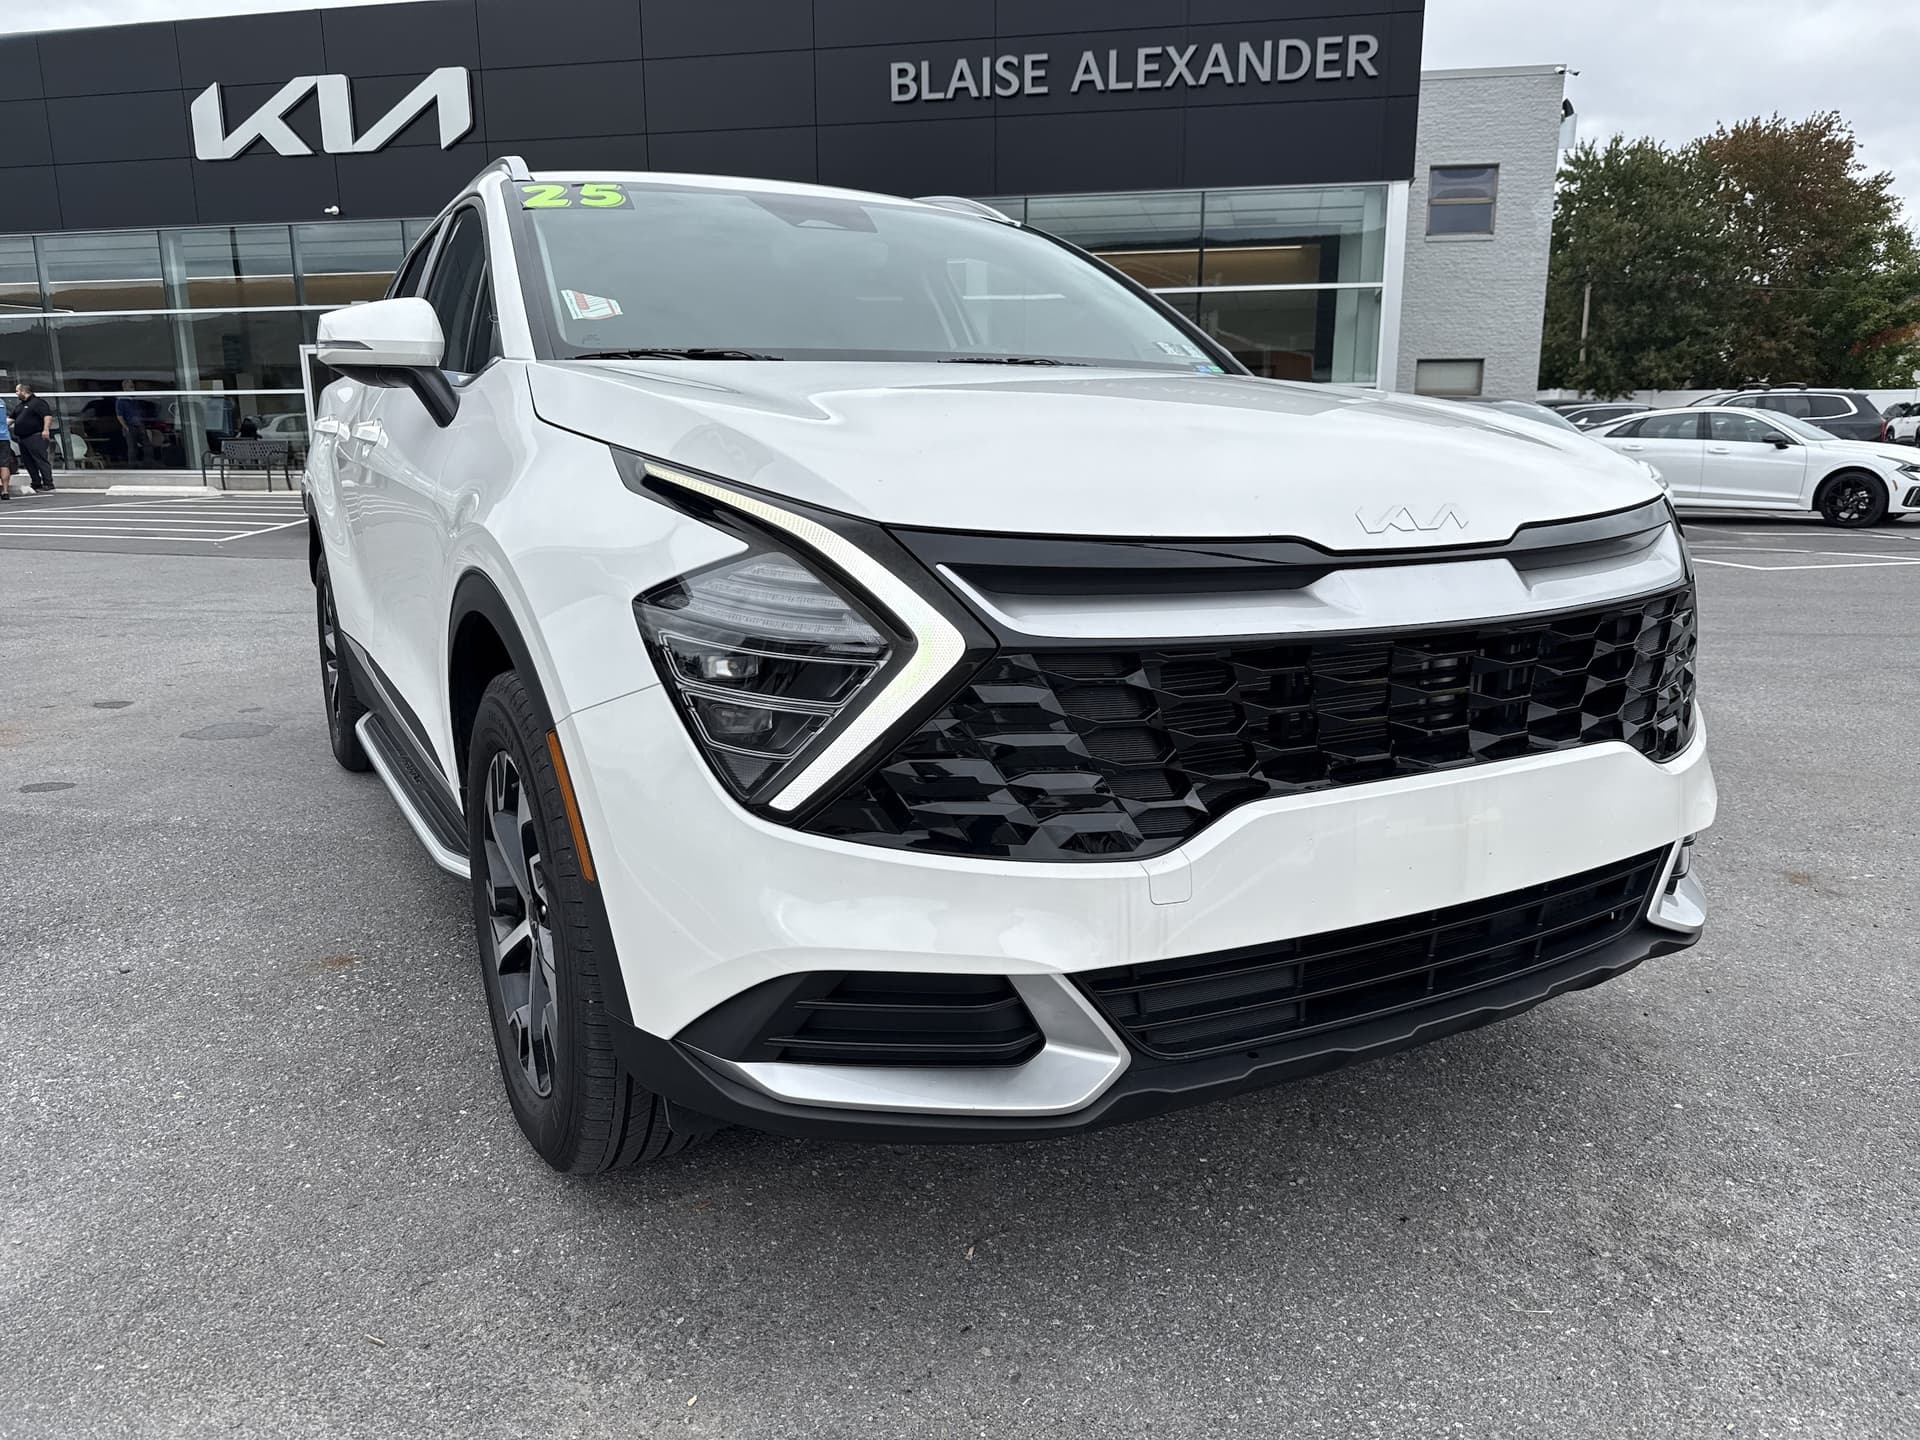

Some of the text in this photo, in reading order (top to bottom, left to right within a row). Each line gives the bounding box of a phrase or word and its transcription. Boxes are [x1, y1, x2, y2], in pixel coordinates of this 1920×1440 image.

[890, 34, 1379, 102] BLAISE ALEXANDER
[190, 66, 472, 160] KIA
[521, 184, 626, 209] 25
[1354, 503, 1469, 534] KIA
